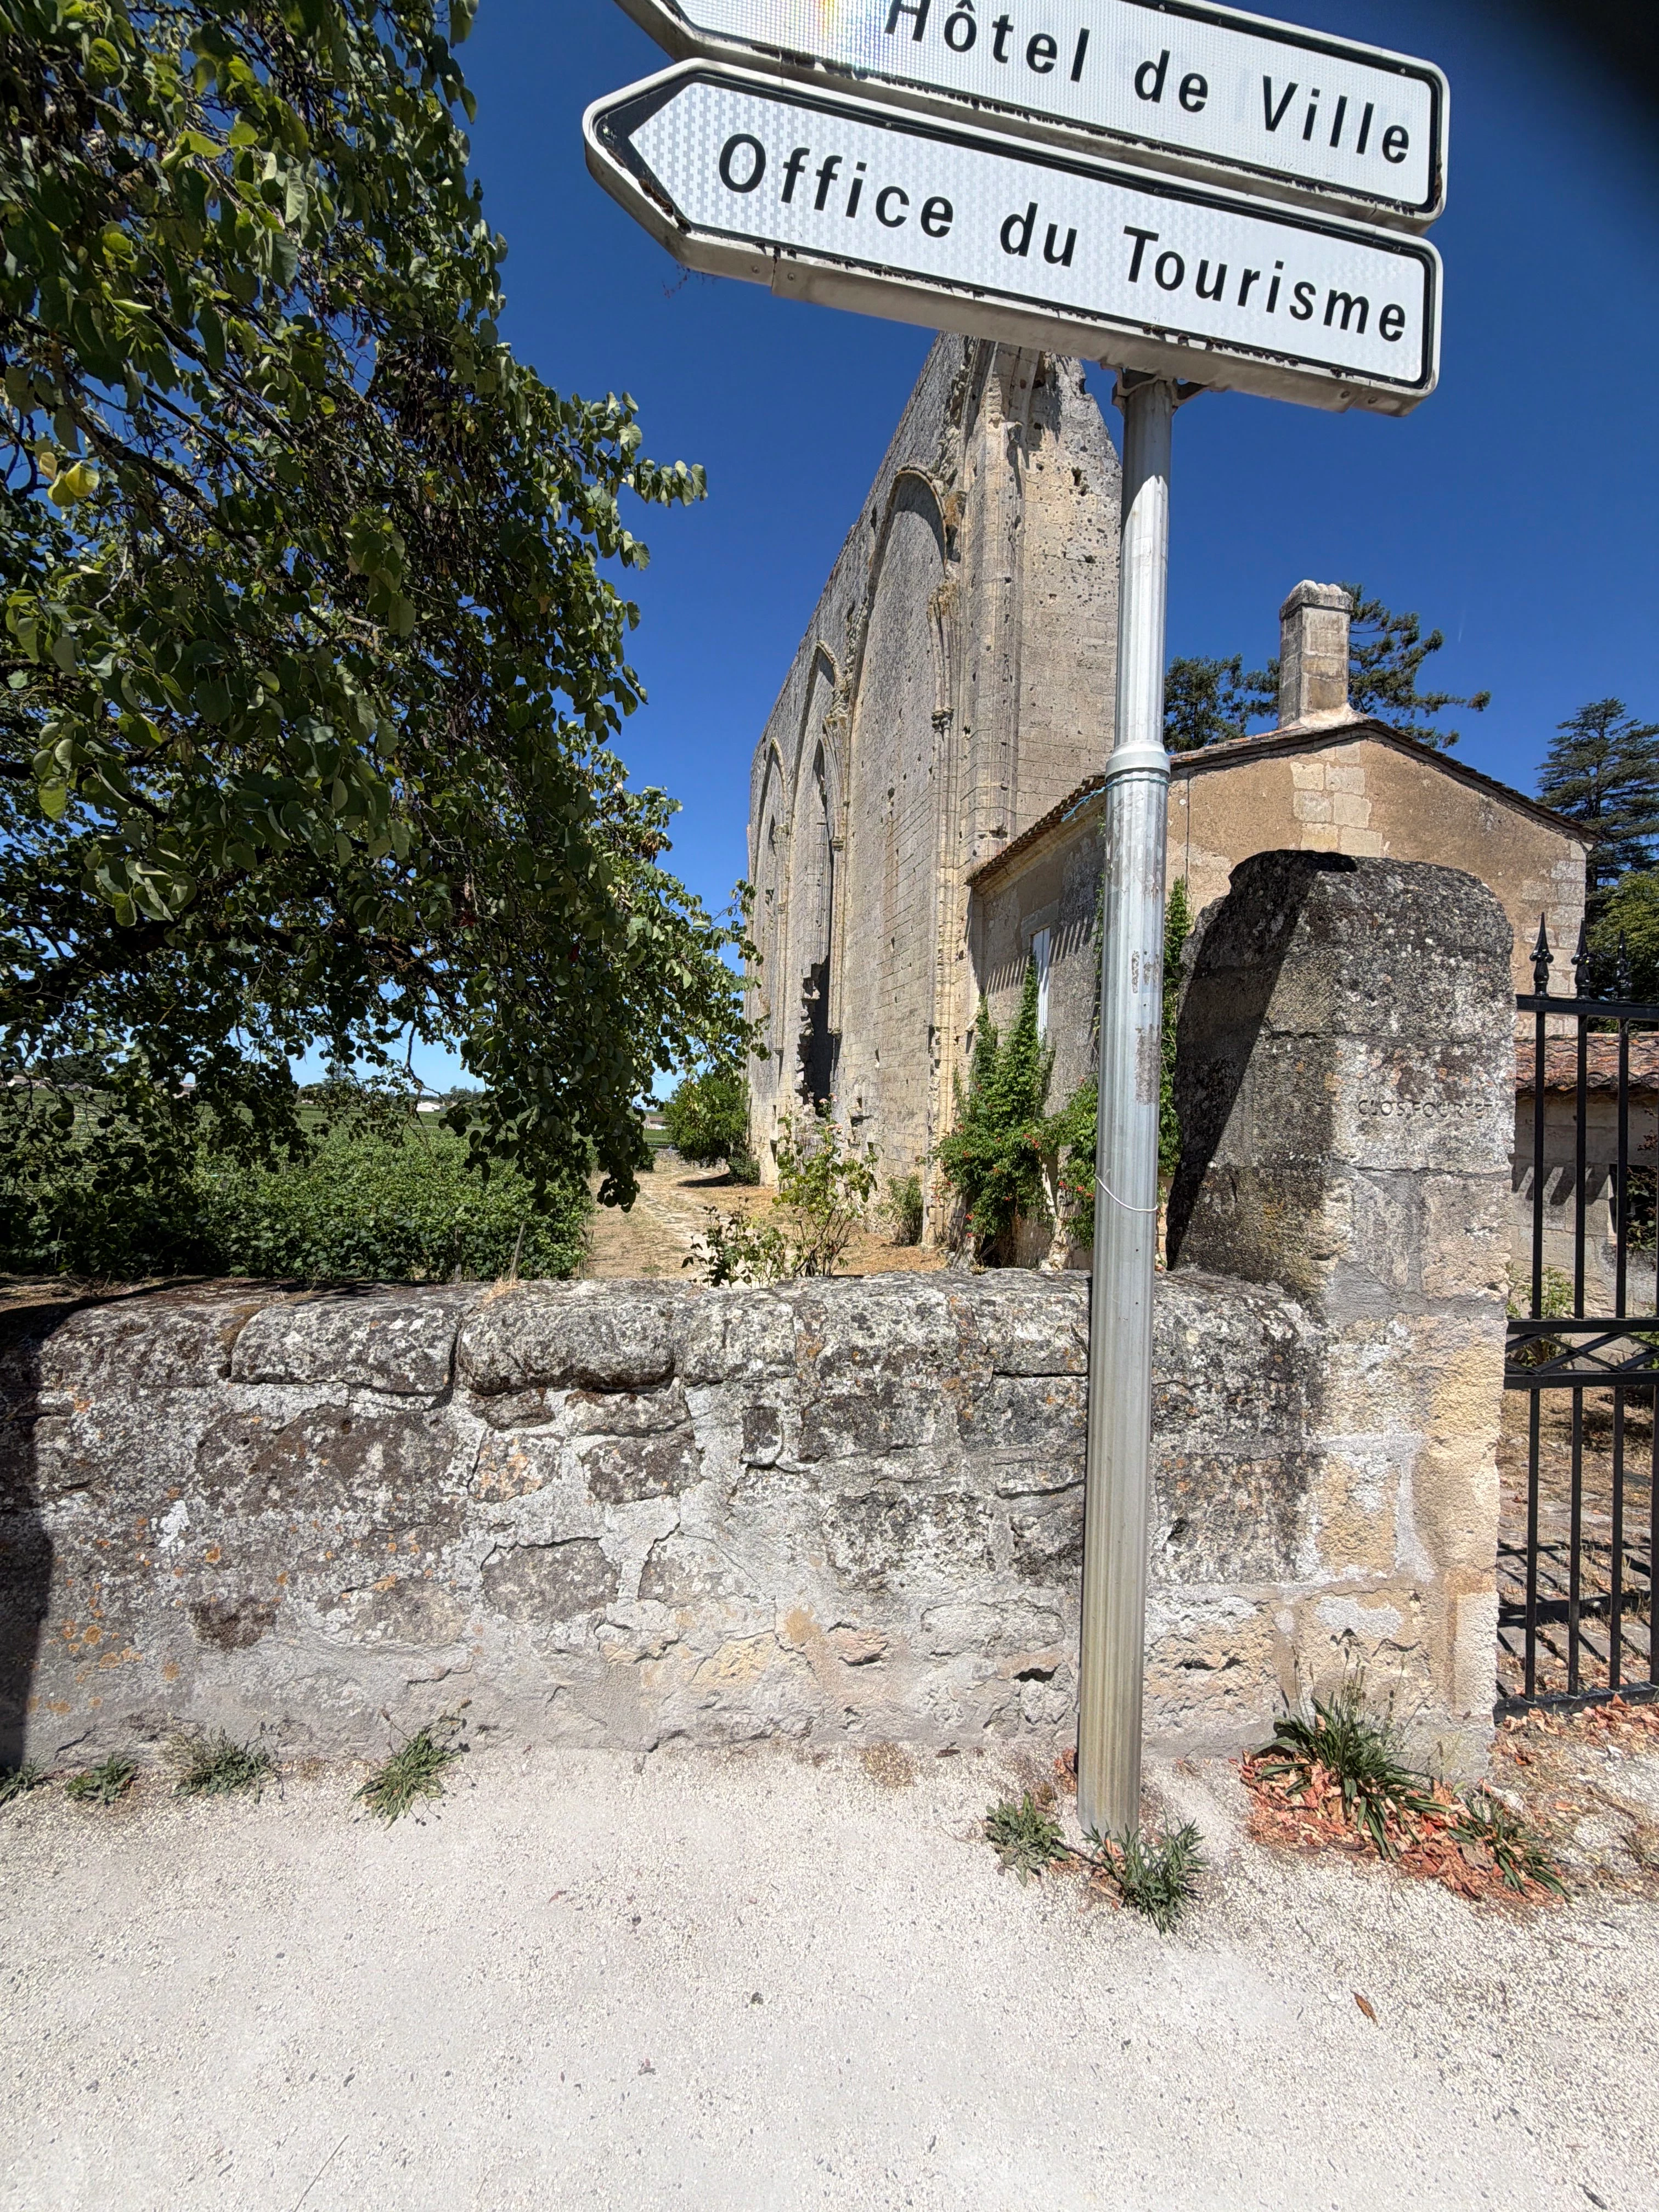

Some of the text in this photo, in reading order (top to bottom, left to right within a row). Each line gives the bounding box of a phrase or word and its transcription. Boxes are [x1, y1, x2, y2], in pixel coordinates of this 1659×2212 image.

[886, 0, 1409, 163] Hôtel de Ville
[719, 134, 1405, 342] Office du Tourisme
[1358, 1099, 1406, 1117] CLOS
